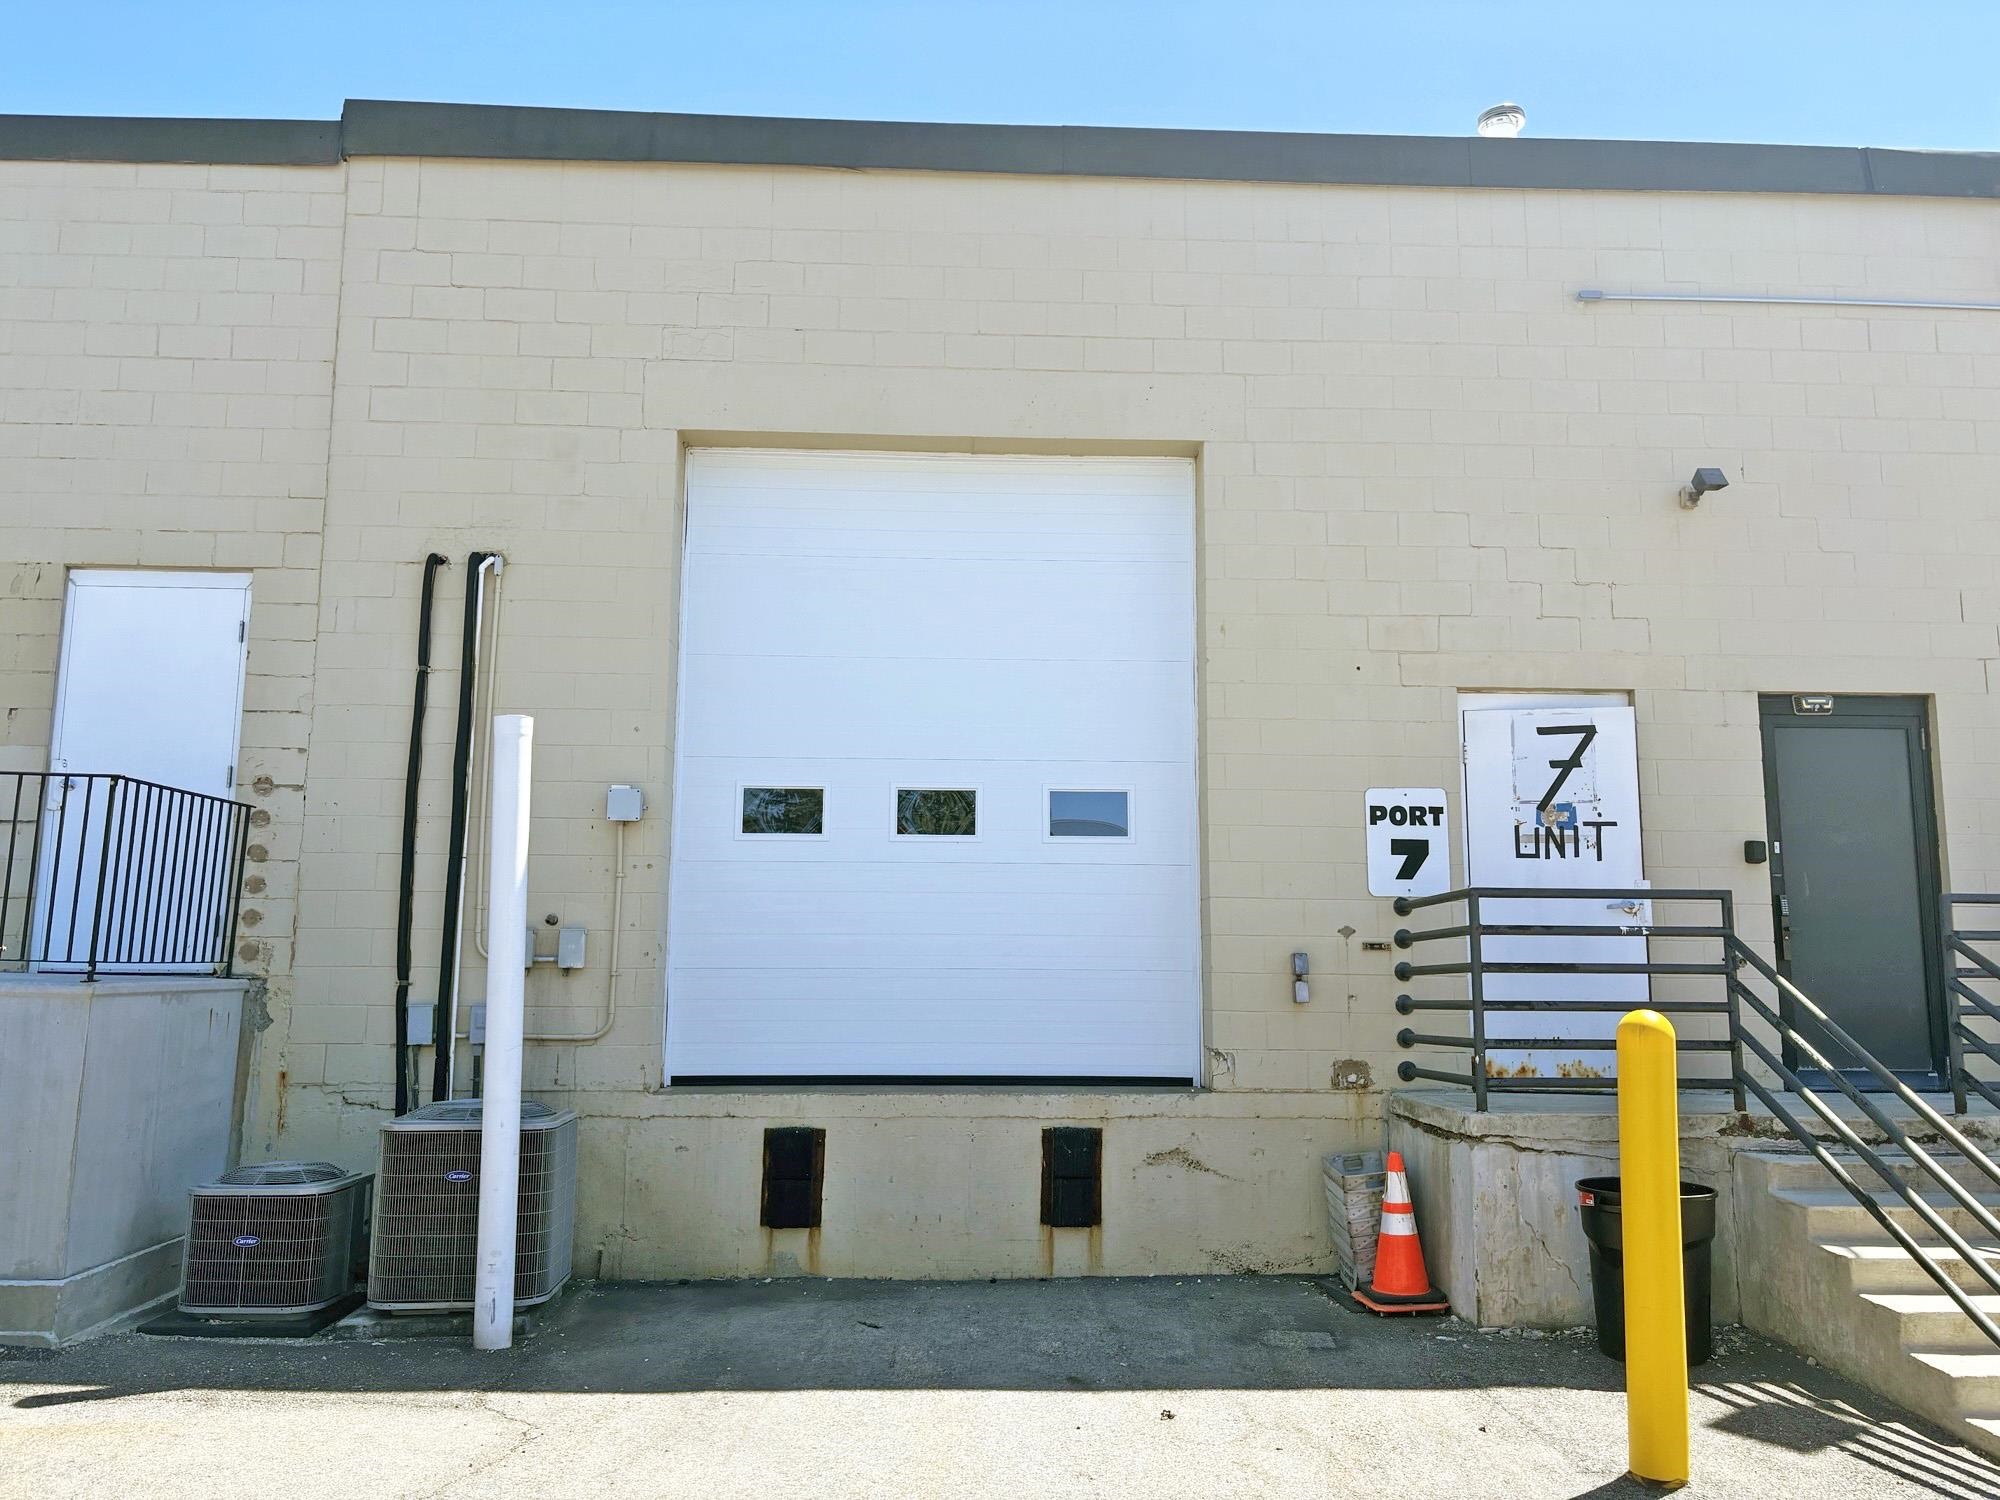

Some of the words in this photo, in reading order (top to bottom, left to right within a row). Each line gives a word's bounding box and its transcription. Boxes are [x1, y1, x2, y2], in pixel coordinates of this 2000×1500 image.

[1536, 725, 1598, 811] 7
[1369, 805, 1444, 826] PORT
[1390, 838, 1429, 880] 7
[1514, 821, 1618, 861] UNIT
